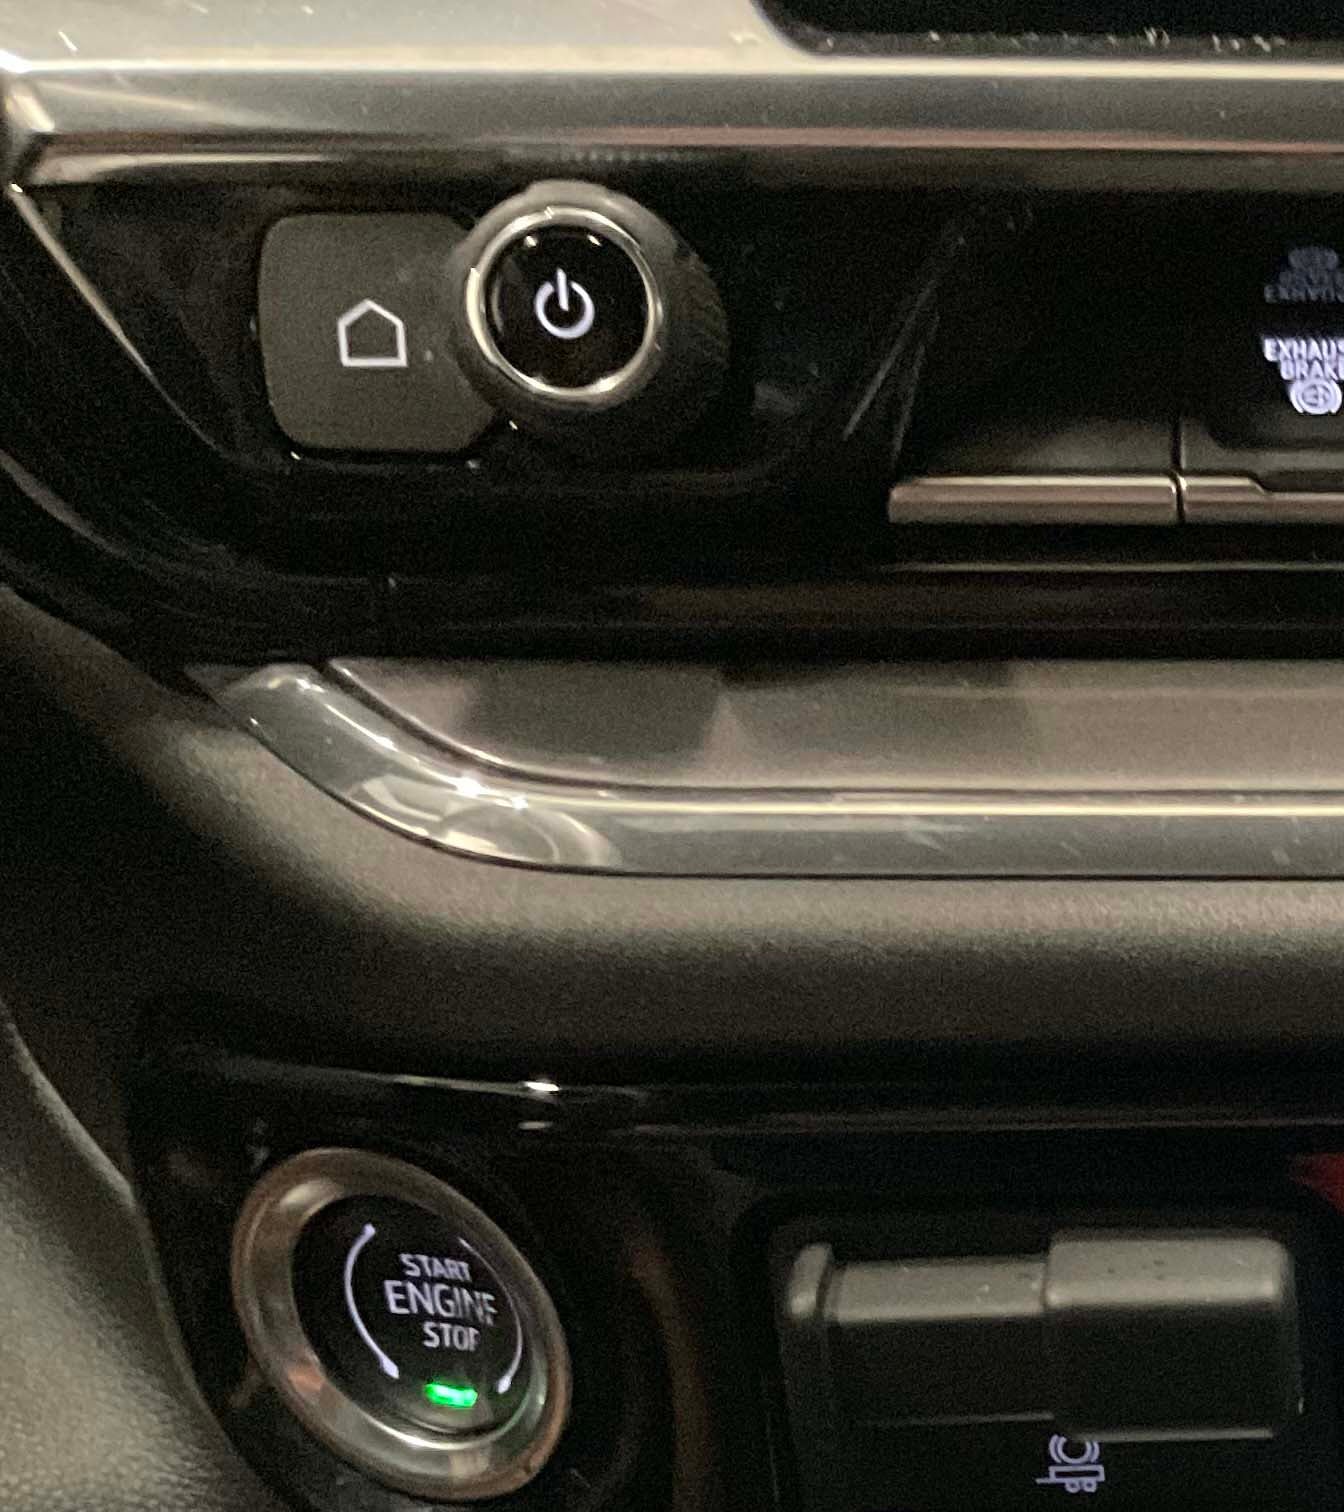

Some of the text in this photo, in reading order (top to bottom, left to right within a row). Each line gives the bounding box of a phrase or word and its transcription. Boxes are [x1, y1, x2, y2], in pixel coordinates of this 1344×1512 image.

[399, 1252, 472, 1282] START
[383, 1279, 499, 1327] ENGINE
[422, 1320, 480, 1352] STOP
